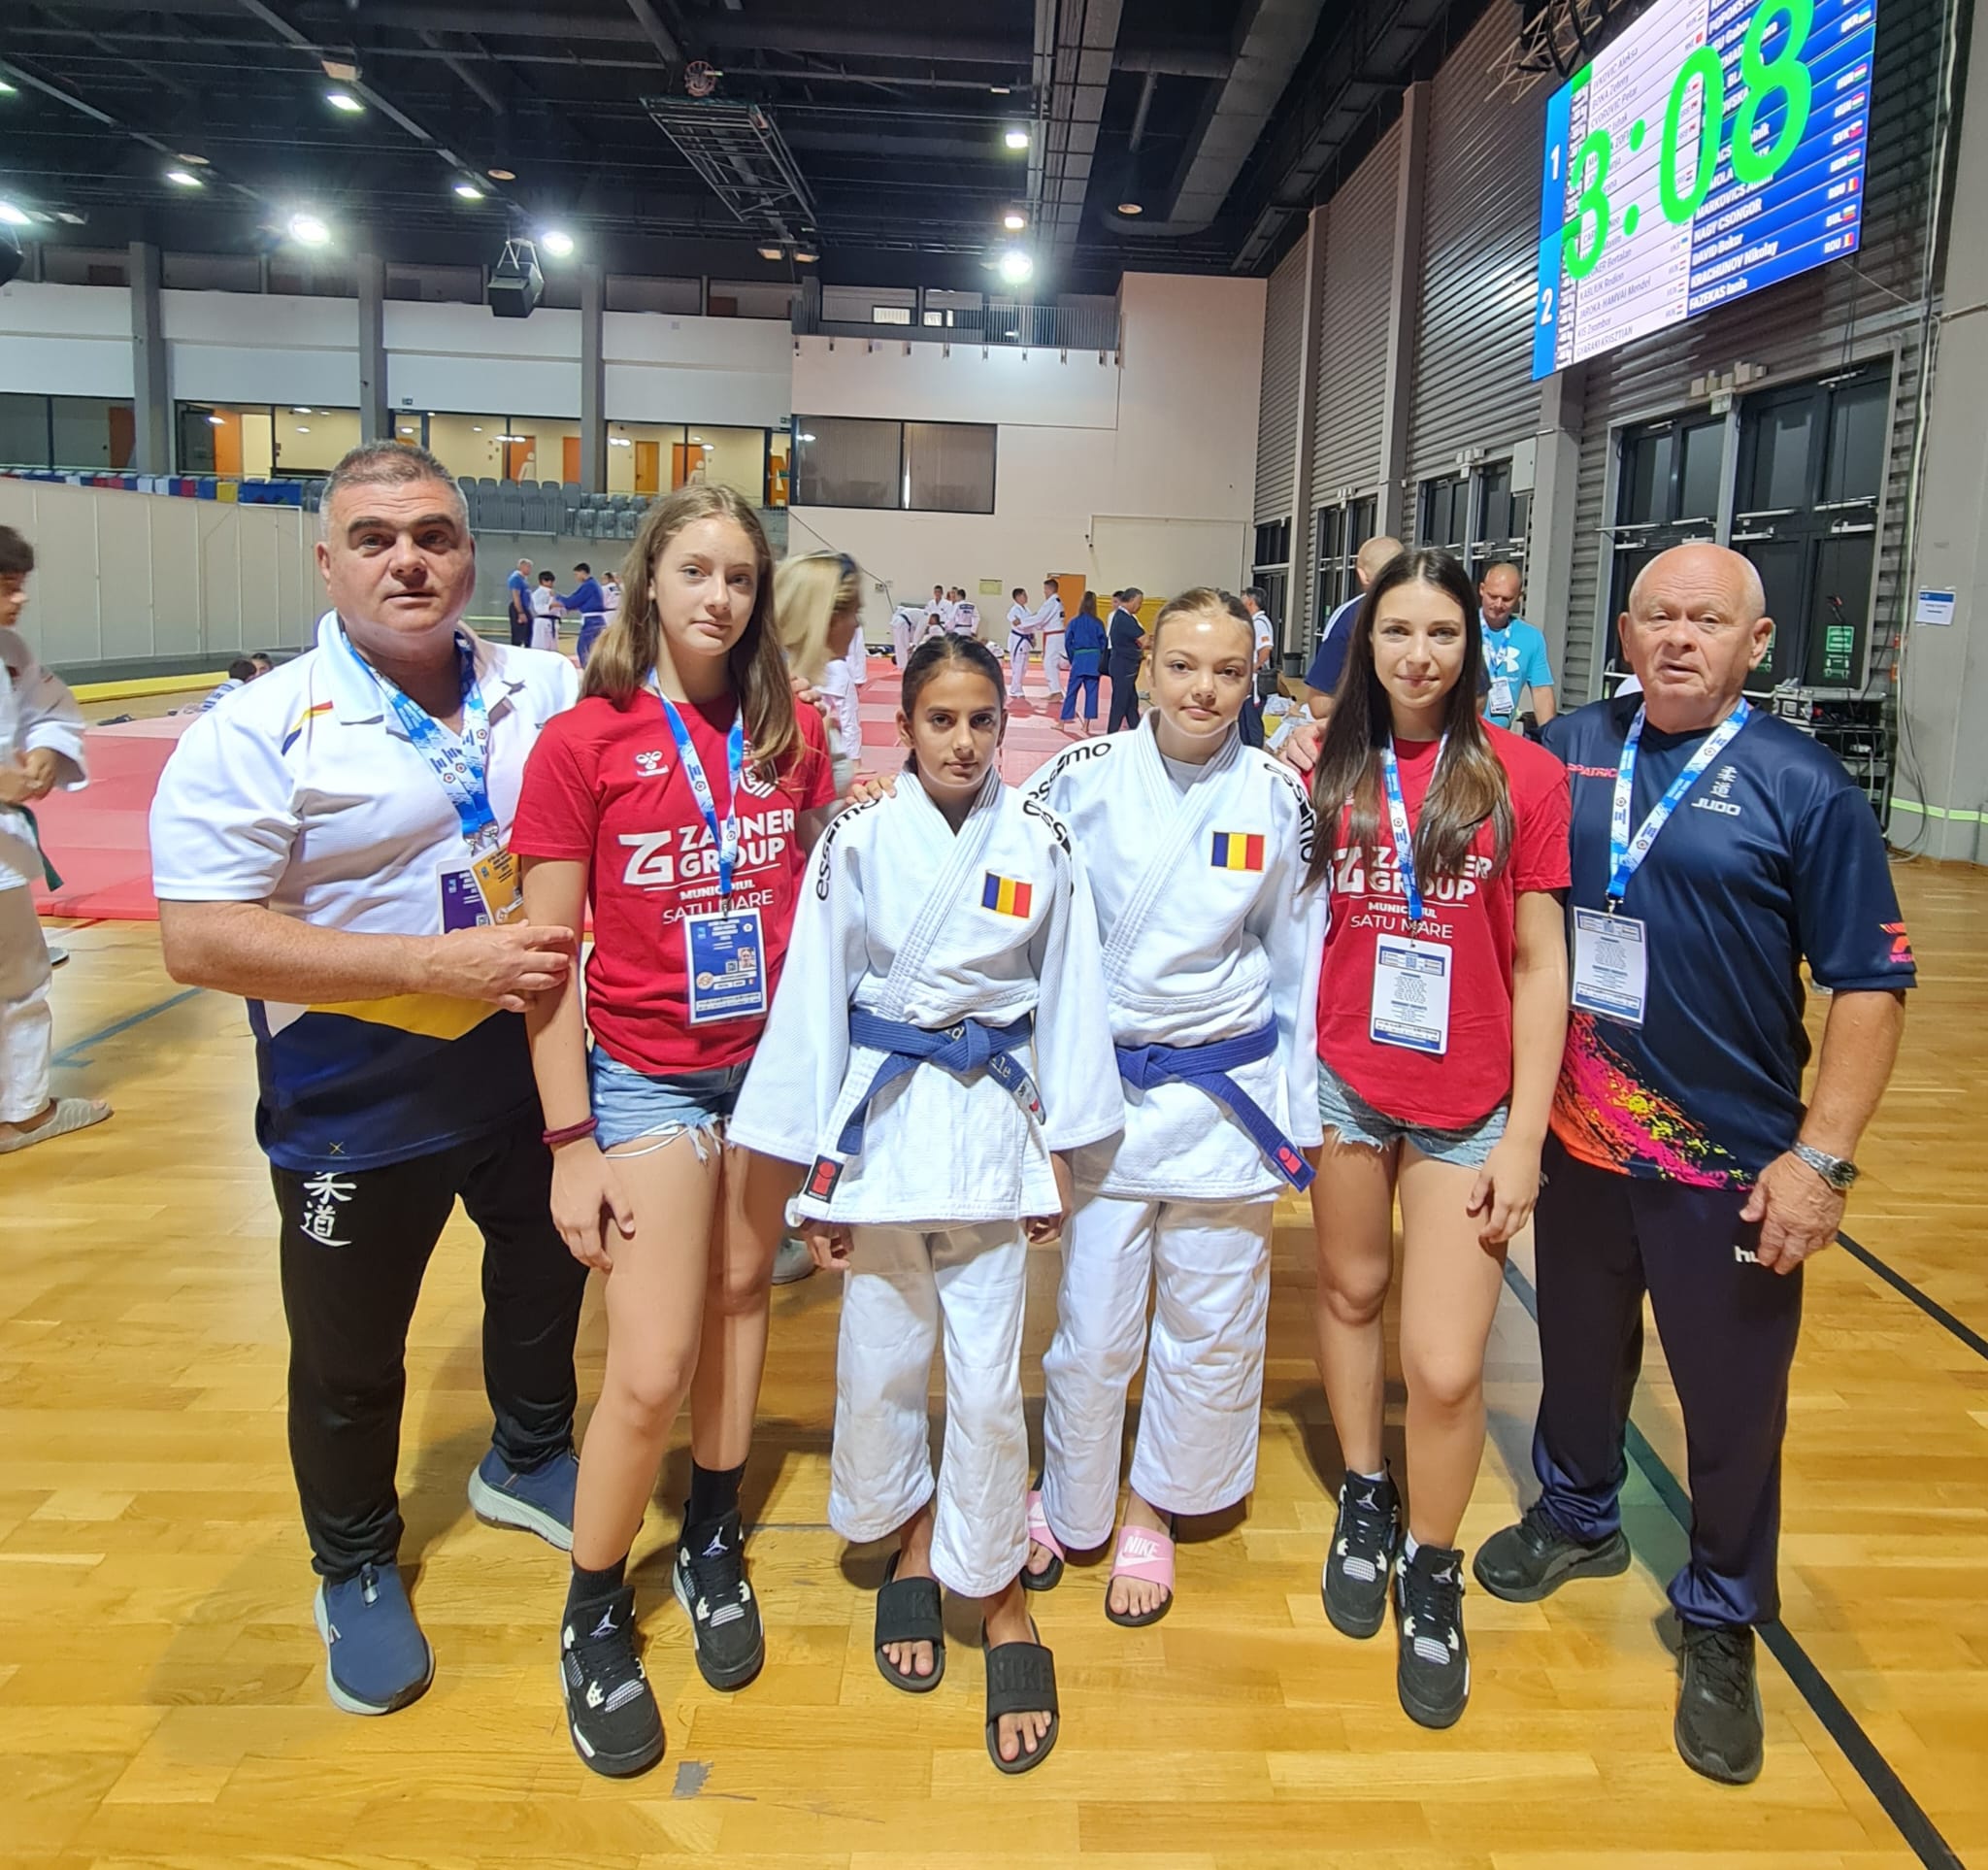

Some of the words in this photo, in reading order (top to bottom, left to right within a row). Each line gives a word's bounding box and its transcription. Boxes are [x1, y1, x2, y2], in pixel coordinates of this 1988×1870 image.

[1550, 144, 1560, 180] 1
[1541, 288, 1553, 325] 2
[1691, 797, 1741, 816] JUDO
[1350, 914, 1396, 931] SATU
[1124, 1535, 1161, 1556] NIKE
